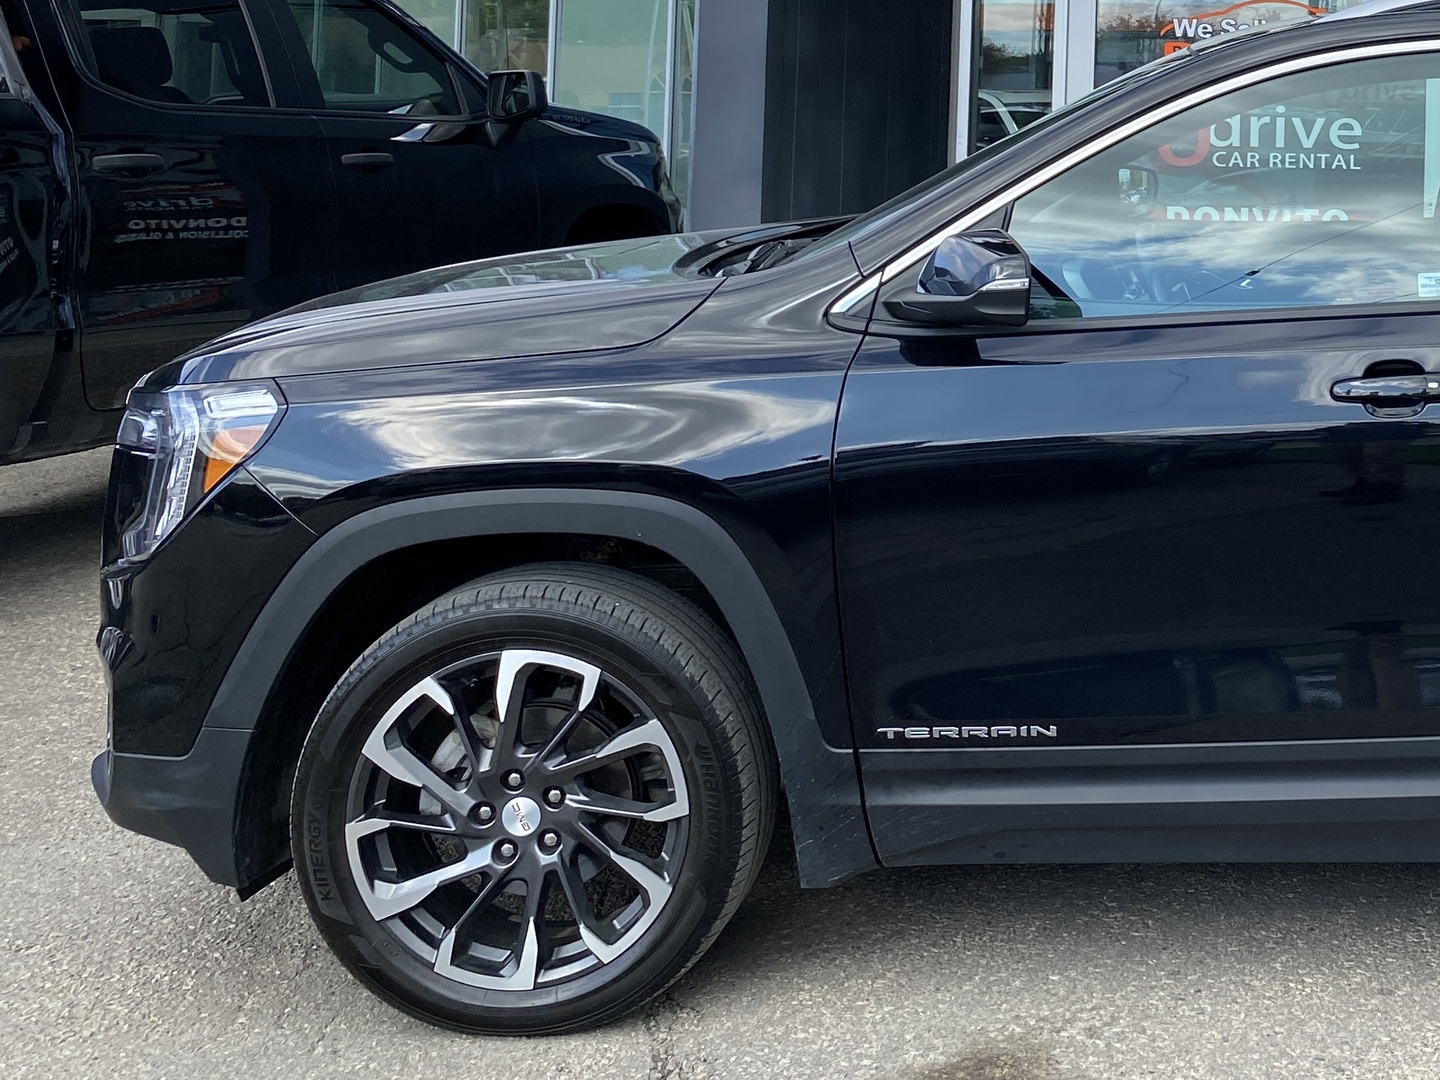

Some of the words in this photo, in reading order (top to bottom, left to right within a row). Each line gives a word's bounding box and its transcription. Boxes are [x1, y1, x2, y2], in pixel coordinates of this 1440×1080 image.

[1172, 18, 1213, 39] We
[1211, 151, 1260, 168] CAR
[1268, 153, 1362, 170] RENTAL
[876, 725, 1058, 740] TERRAIN
[511, 802, 531, 832] GMC
[307, 813, 335, 902] KINERGY
